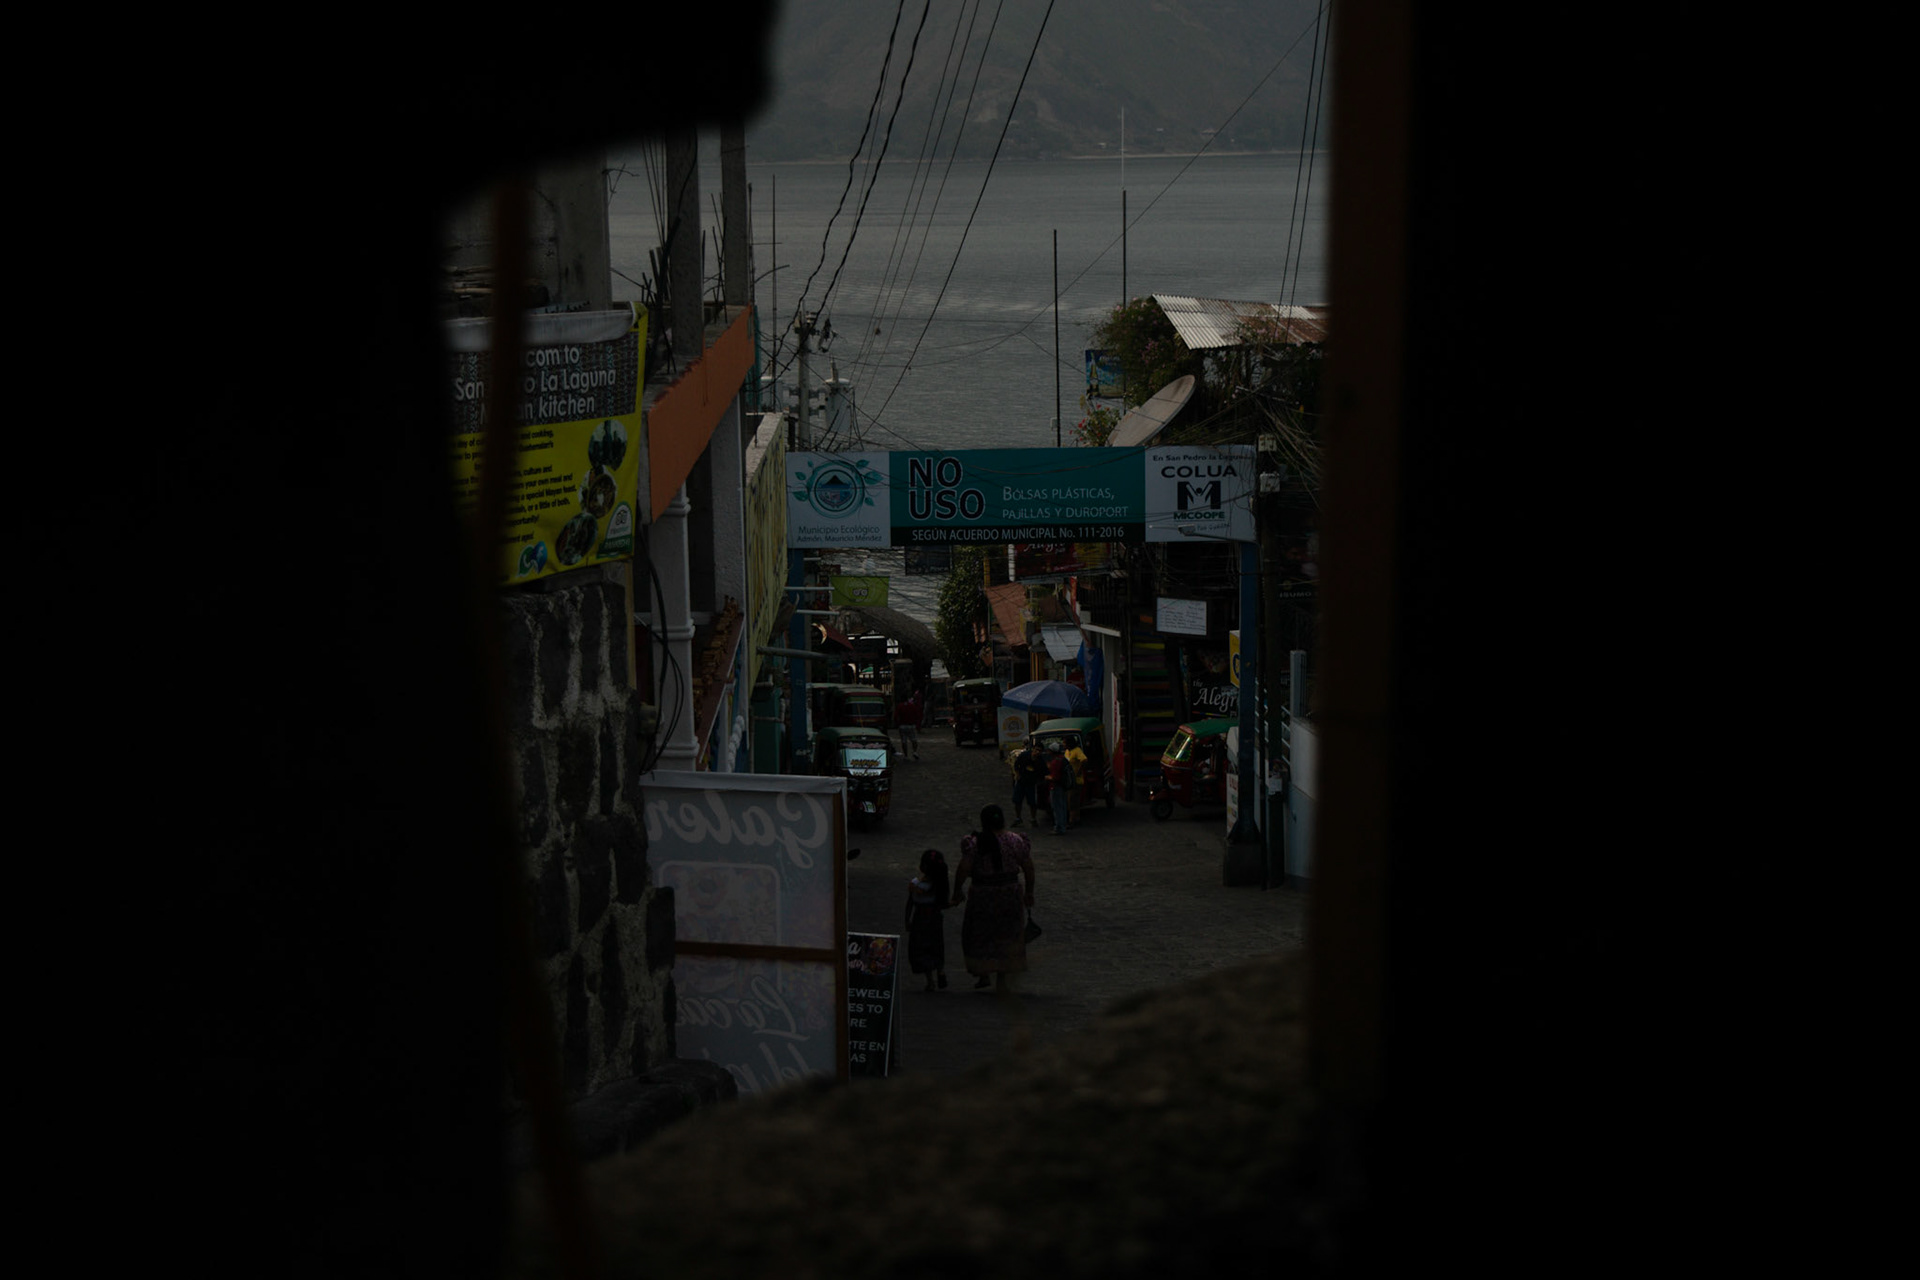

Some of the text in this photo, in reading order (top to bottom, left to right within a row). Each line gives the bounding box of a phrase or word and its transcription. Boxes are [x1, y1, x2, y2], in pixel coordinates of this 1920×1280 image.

[524, 345, 580, 368] com to
[454, 377, 485, 401] San
[540, 370, 559, 393] La
[563, 368, 617, 394] Laguna
[538, 395, 595, 420] kitchen
[1152, 454, 1164, 462] En
[1165, 454, 1181, 462] San
[1183, 453, 1207, 462] Pedro
[908, 456, 964, 489] NO
[1160, 464, 1238, 479] COLUA
[908, 488, 987, 521] USO
[1002, 505, 1129, 520] PAJILLAS Y DUROPORT
[1173, 511, 1226, 521] MICOOPE
[798, 524, 880, 537] Municipio Ecológico
[911, 527, 946, 541] SEGÚN
[949, 527, 999, 541] ACUERDO
[1001, 527, 1057, 540] MUNICIPAL
[1078, 526, 1125, 539] 111-2016
[1192, 685, 1238, 713] Alegr
[849, 987, 892, 1000] EWELS
[849, 1003, 884, 1015] ES TO
[850, 1018, 867, 1028] RE
[869, 1041, 885, 1052] EN
[850, 1053, 867, 1064] AS
